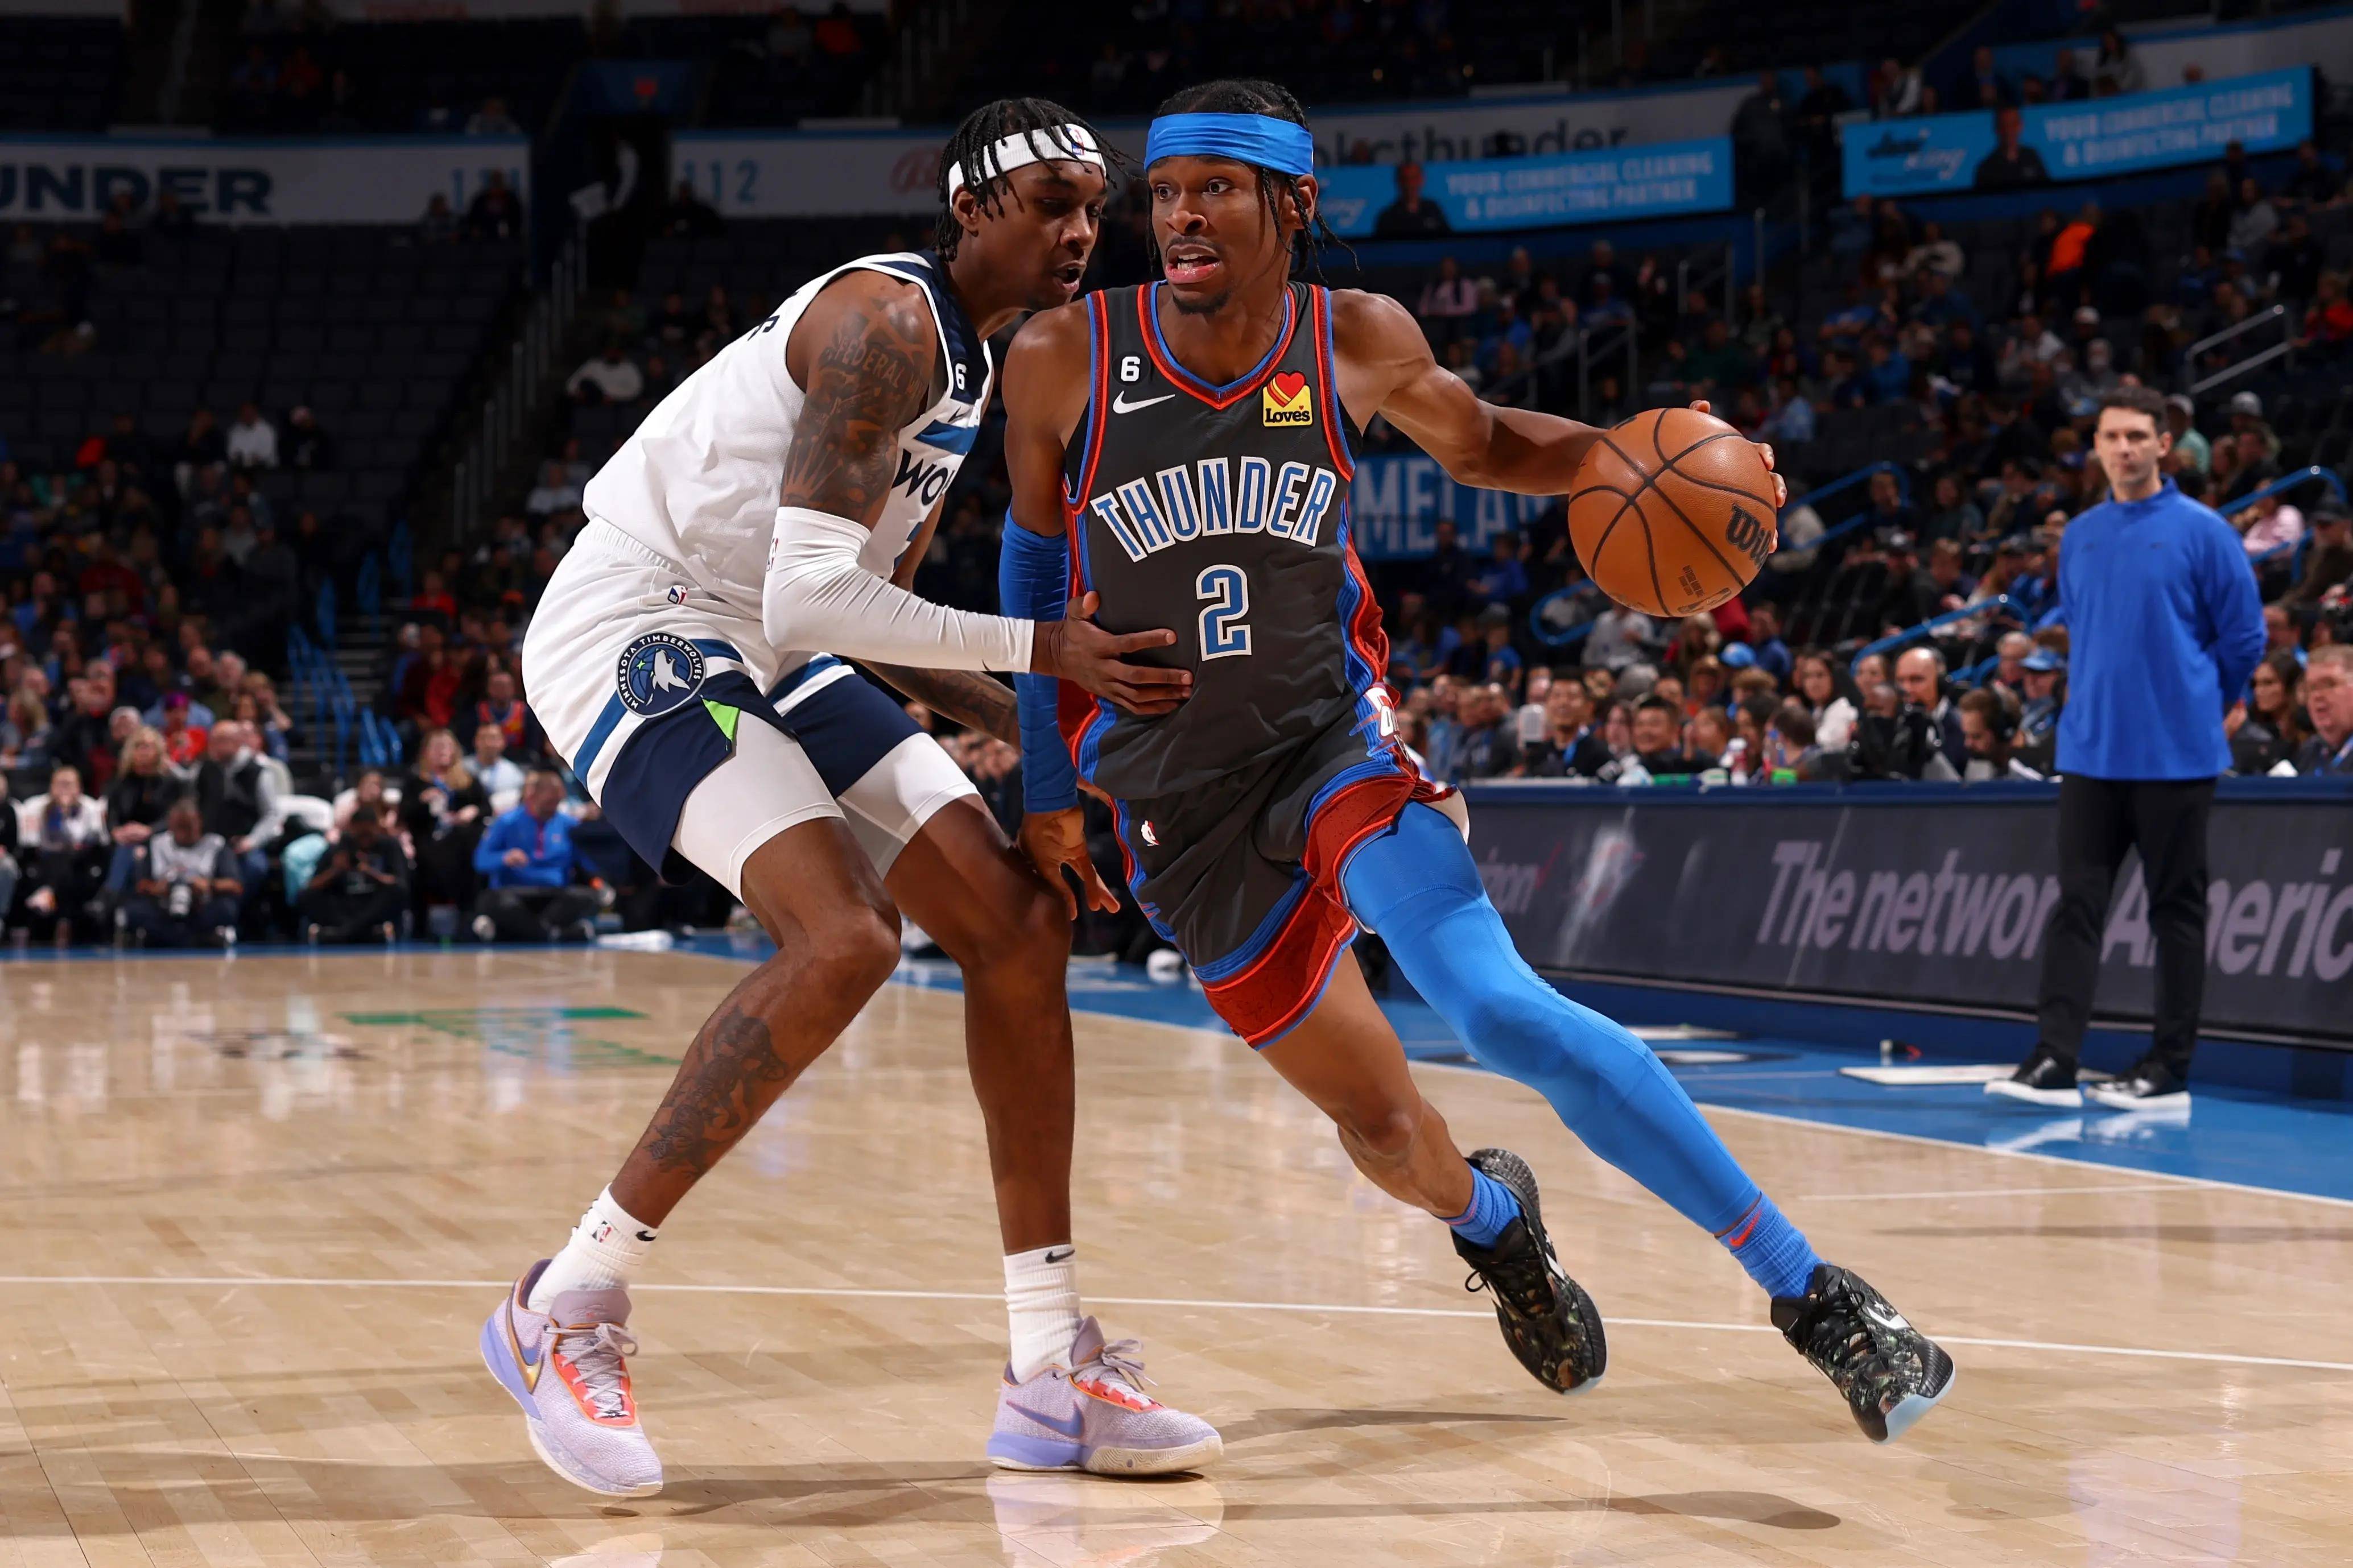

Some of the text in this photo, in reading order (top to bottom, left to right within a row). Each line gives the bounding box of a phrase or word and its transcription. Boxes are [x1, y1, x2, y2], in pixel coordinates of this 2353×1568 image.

[955, 363, 967, 390] 6
[1120, 357, 1141, 382] 6
[891, 448, 955, 505] WO
[1090, 457, 1337, 562] THUNDER
[1195, 564, 1251, 661] 2
[620, 635, 701, 709] MINNESOTA TIMBERWOLVES
[1756, 841, 1857, 951] The
